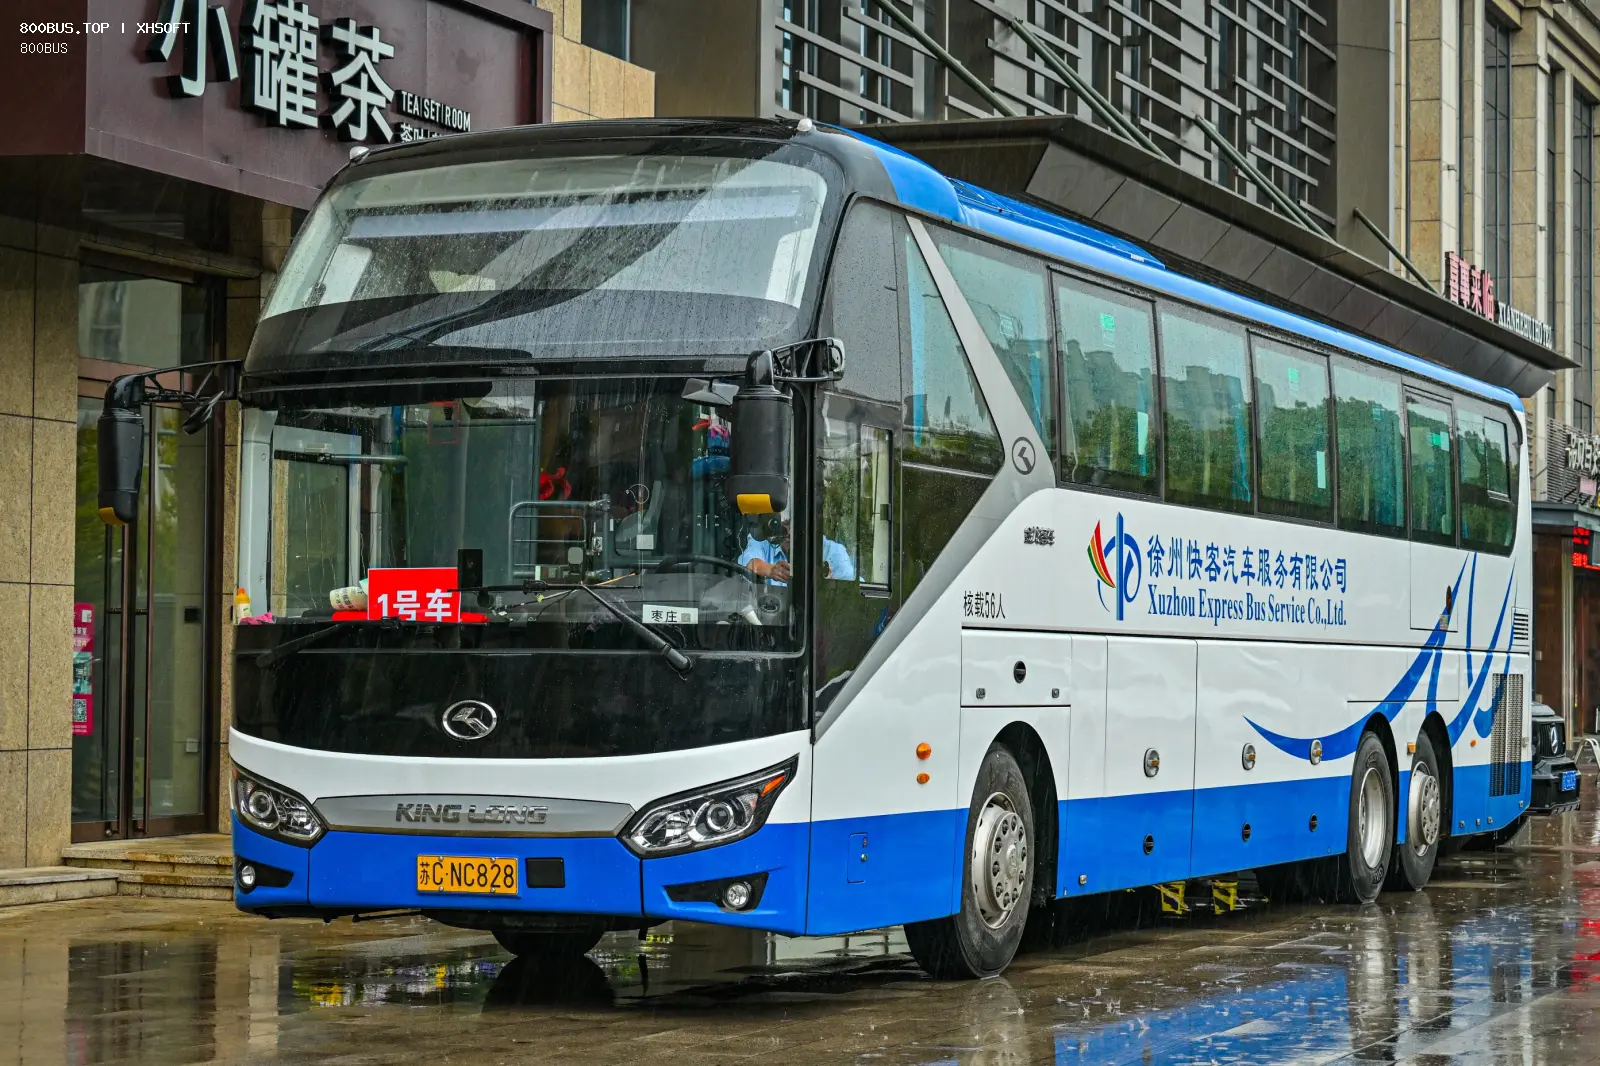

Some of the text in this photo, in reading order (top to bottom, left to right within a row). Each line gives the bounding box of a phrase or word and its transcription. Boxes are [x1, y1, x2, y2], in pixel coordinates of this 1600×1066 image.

[160, 0, 395, 143] 小罐茶
[1147, 534, 1347, 594] 徐州快客汽车服务有限公司
[377, 588, 453, 623] 1号车
[651, 610, 678, 623] 枣庄
[1147, 584, 1196, 617] Xuzhou
[1198, 588, 1244, 626] Express
[1245, 592, 1266, 622] Bus
[1267, 593, 1306, 624] Service
[395, 803, 549, 825] KING LONG
